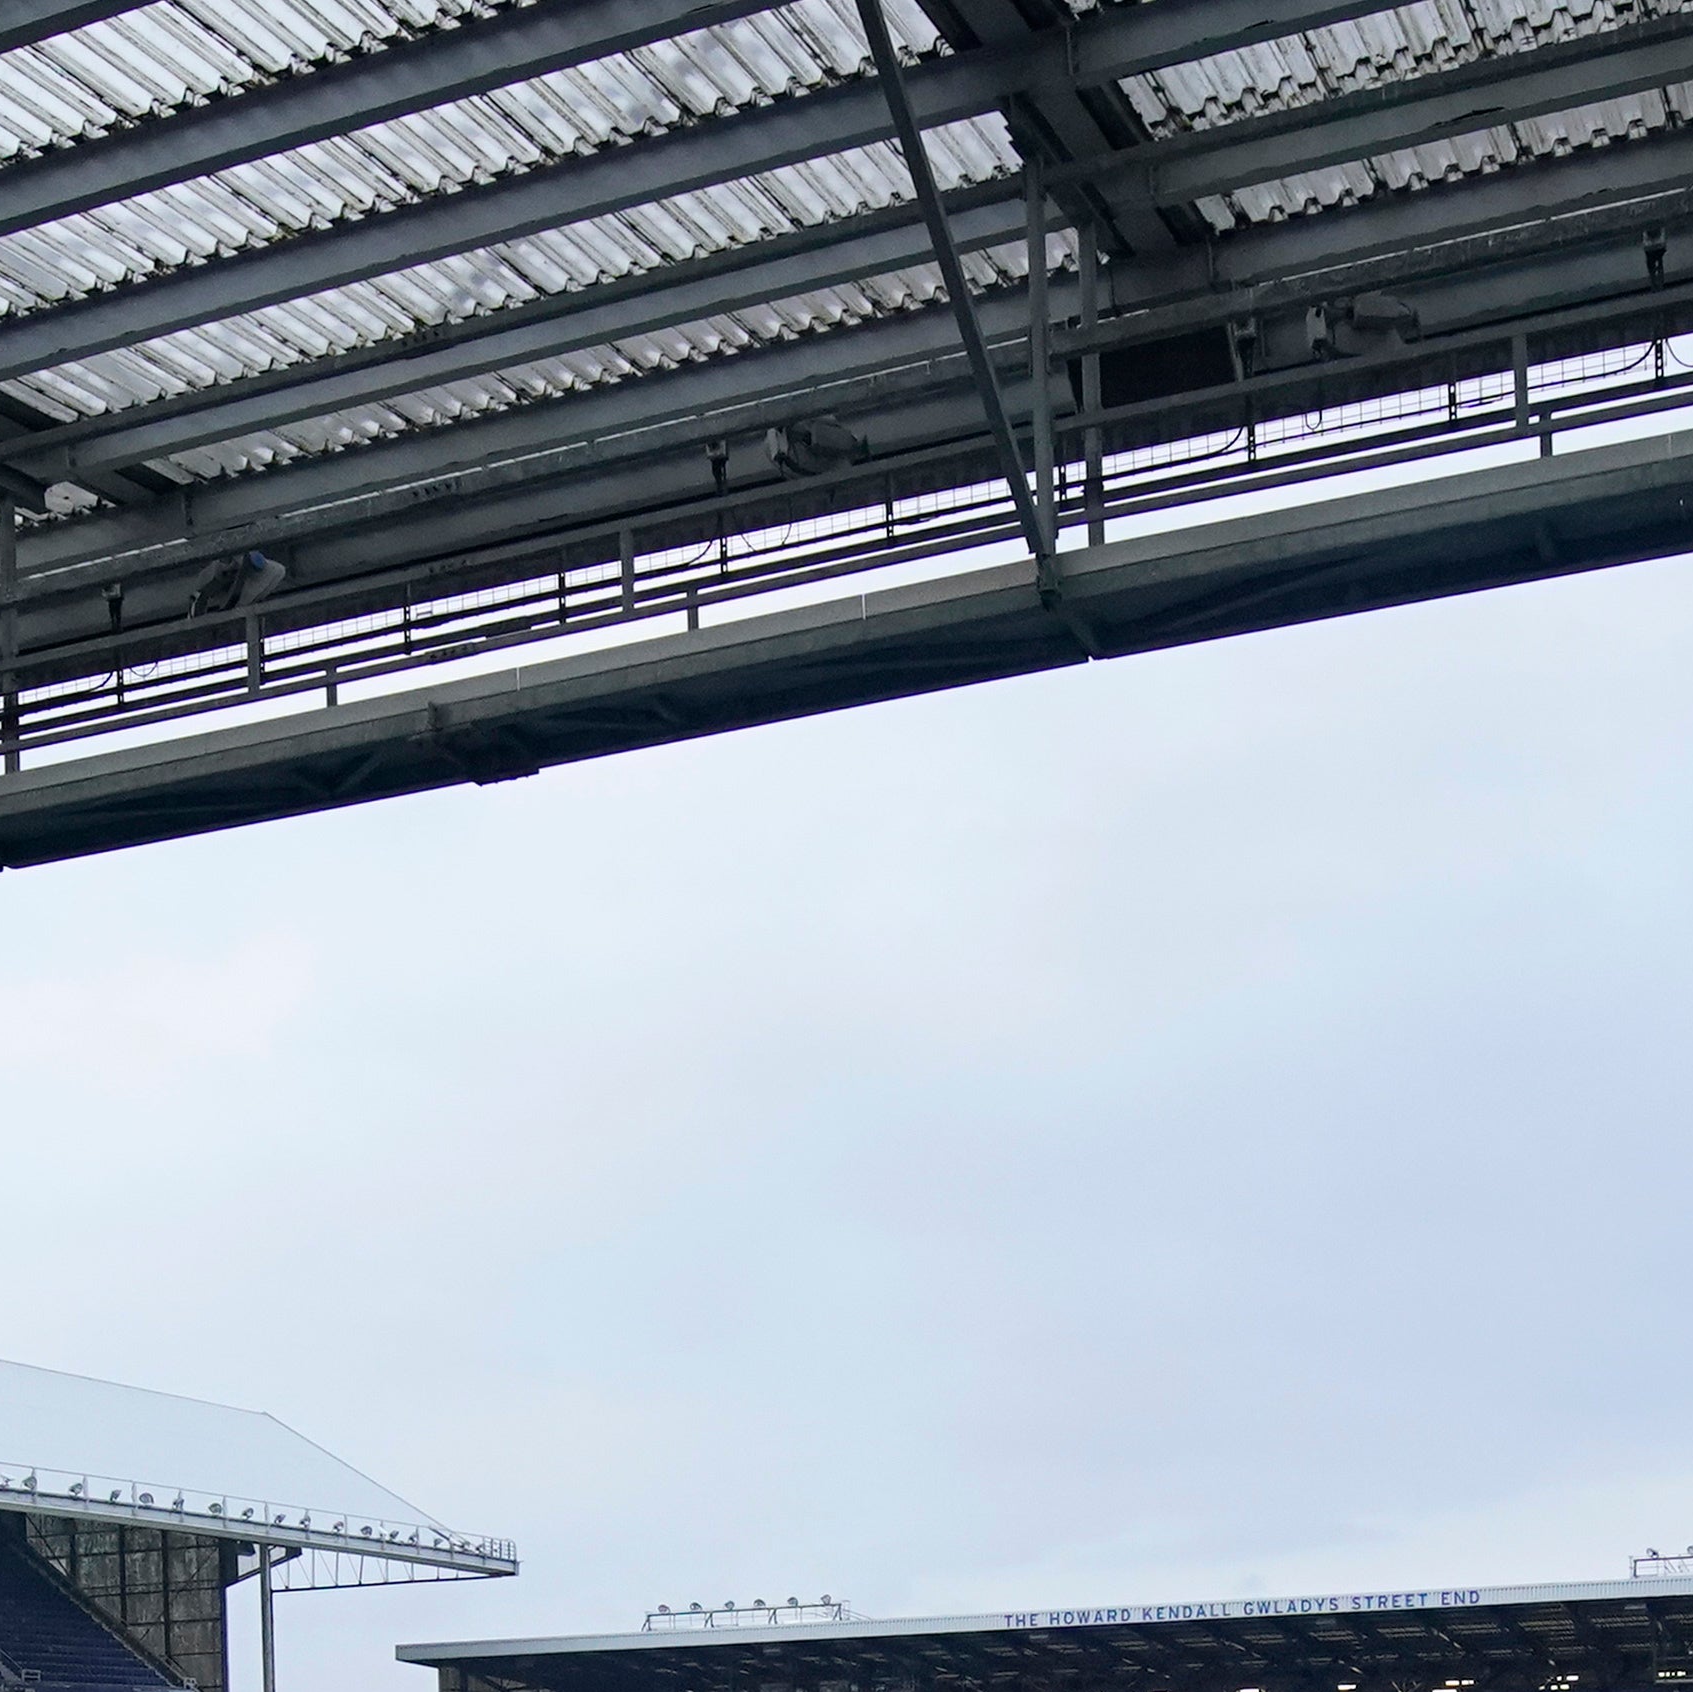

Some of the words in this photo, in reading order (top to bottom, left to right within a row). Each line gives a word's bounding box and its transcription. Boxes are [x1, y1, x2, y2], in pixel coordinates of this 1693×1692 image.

[1003, 1613, 1039, 1628] THE
[1048, 1608, 1131, 1626] HOWARD
[1141, 1604, 1232, 1621] KENDALL
[1243, 1597, 1339, 1616] GWLADYS
[1351, 1592, 1428, 1610] STREET
[1440, 1590, 1481, 1606] END
